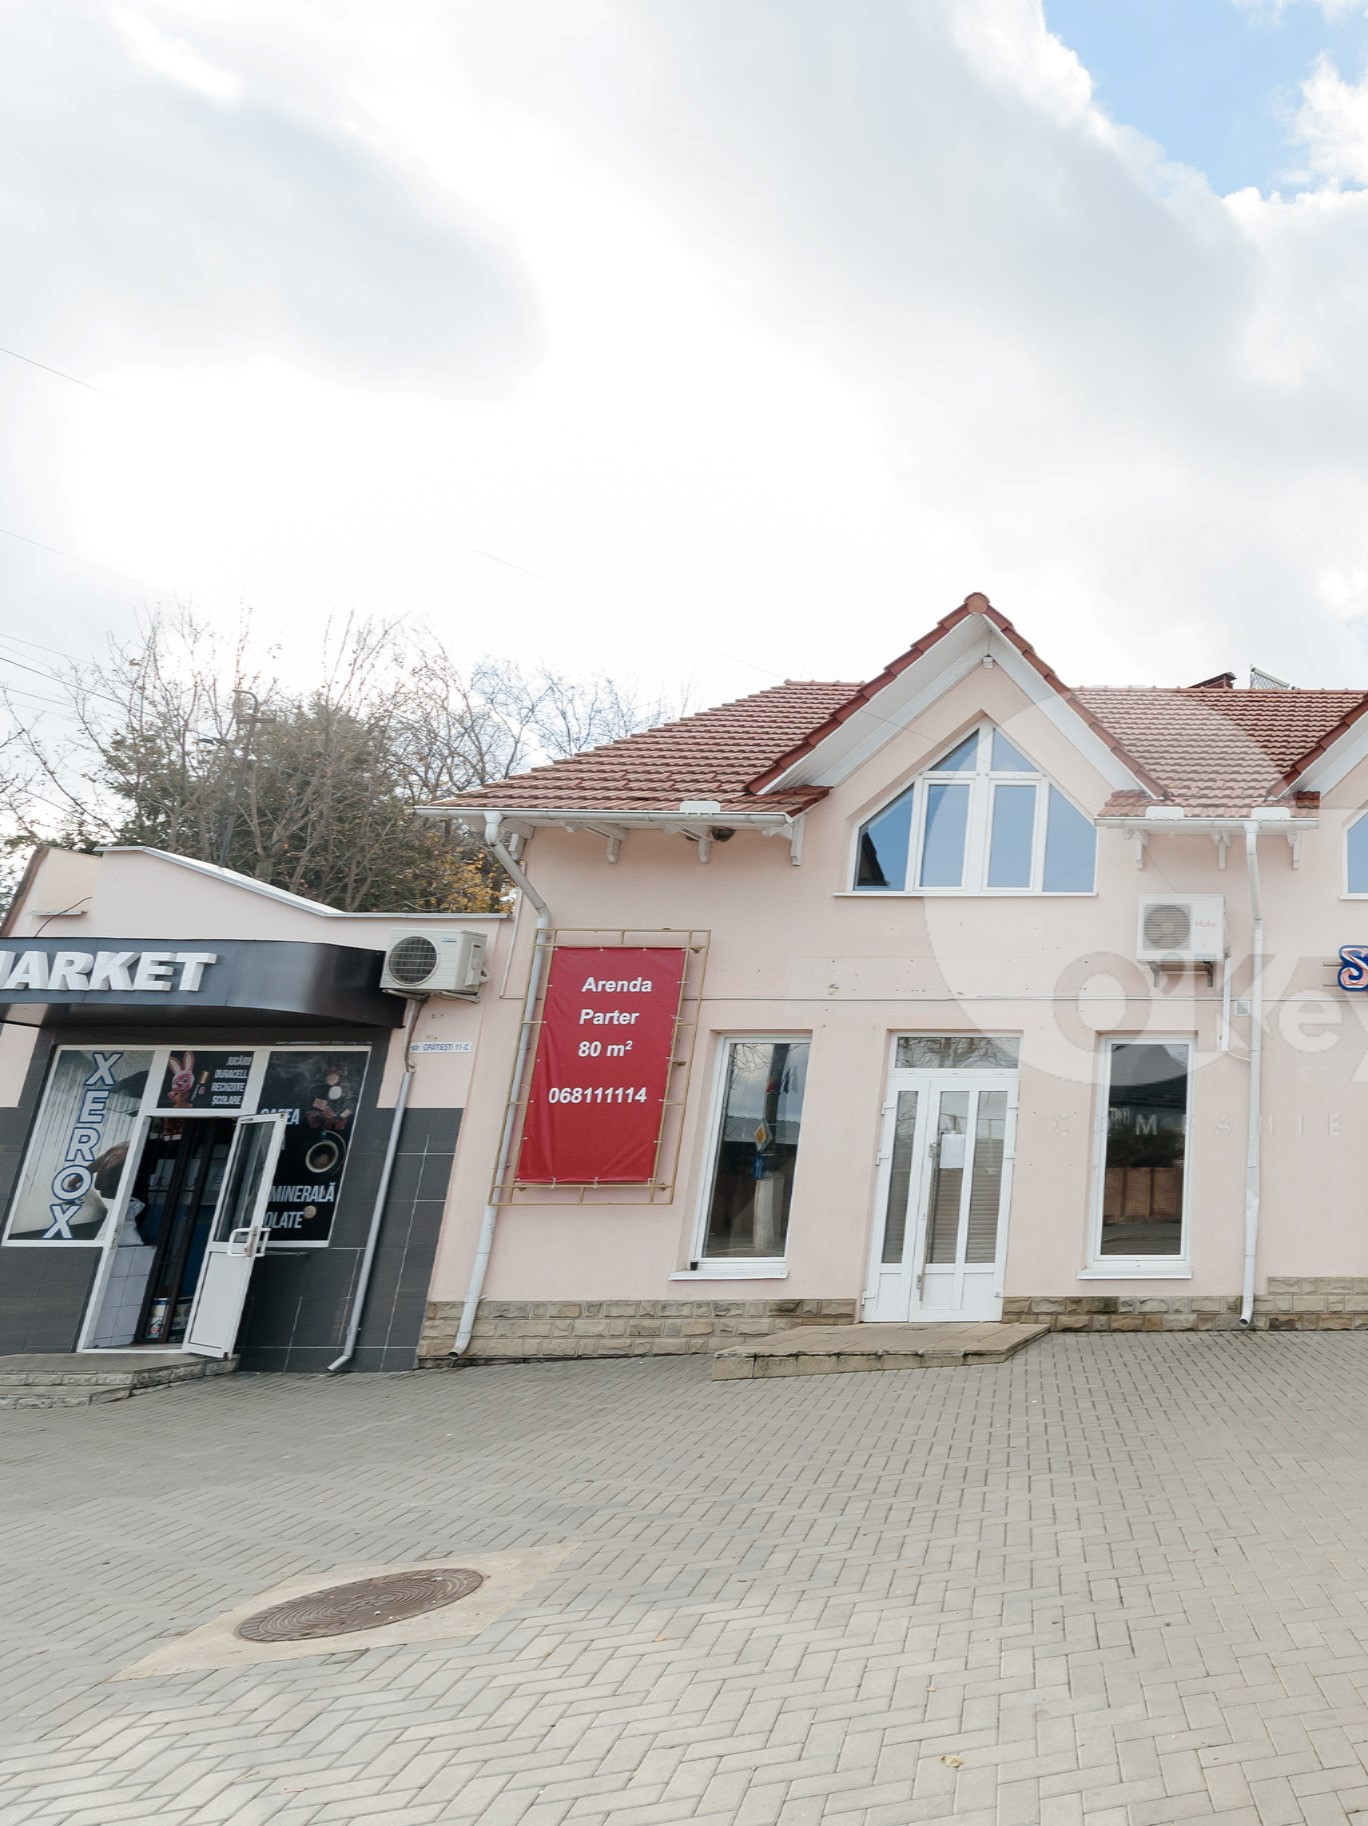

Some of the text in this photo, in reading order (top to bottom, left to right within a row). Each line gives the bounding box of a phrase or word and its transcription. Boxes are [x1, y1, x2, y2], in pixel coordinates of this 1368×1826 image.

[581, 976, 653, 993] Arenda
[579, 1008, 640, 1025] Parter
[578, 1041, 601, 1057] 80
[549, 1087, 647, 1103] 068111114
[42, 1052, 123, 1239] XEROX
